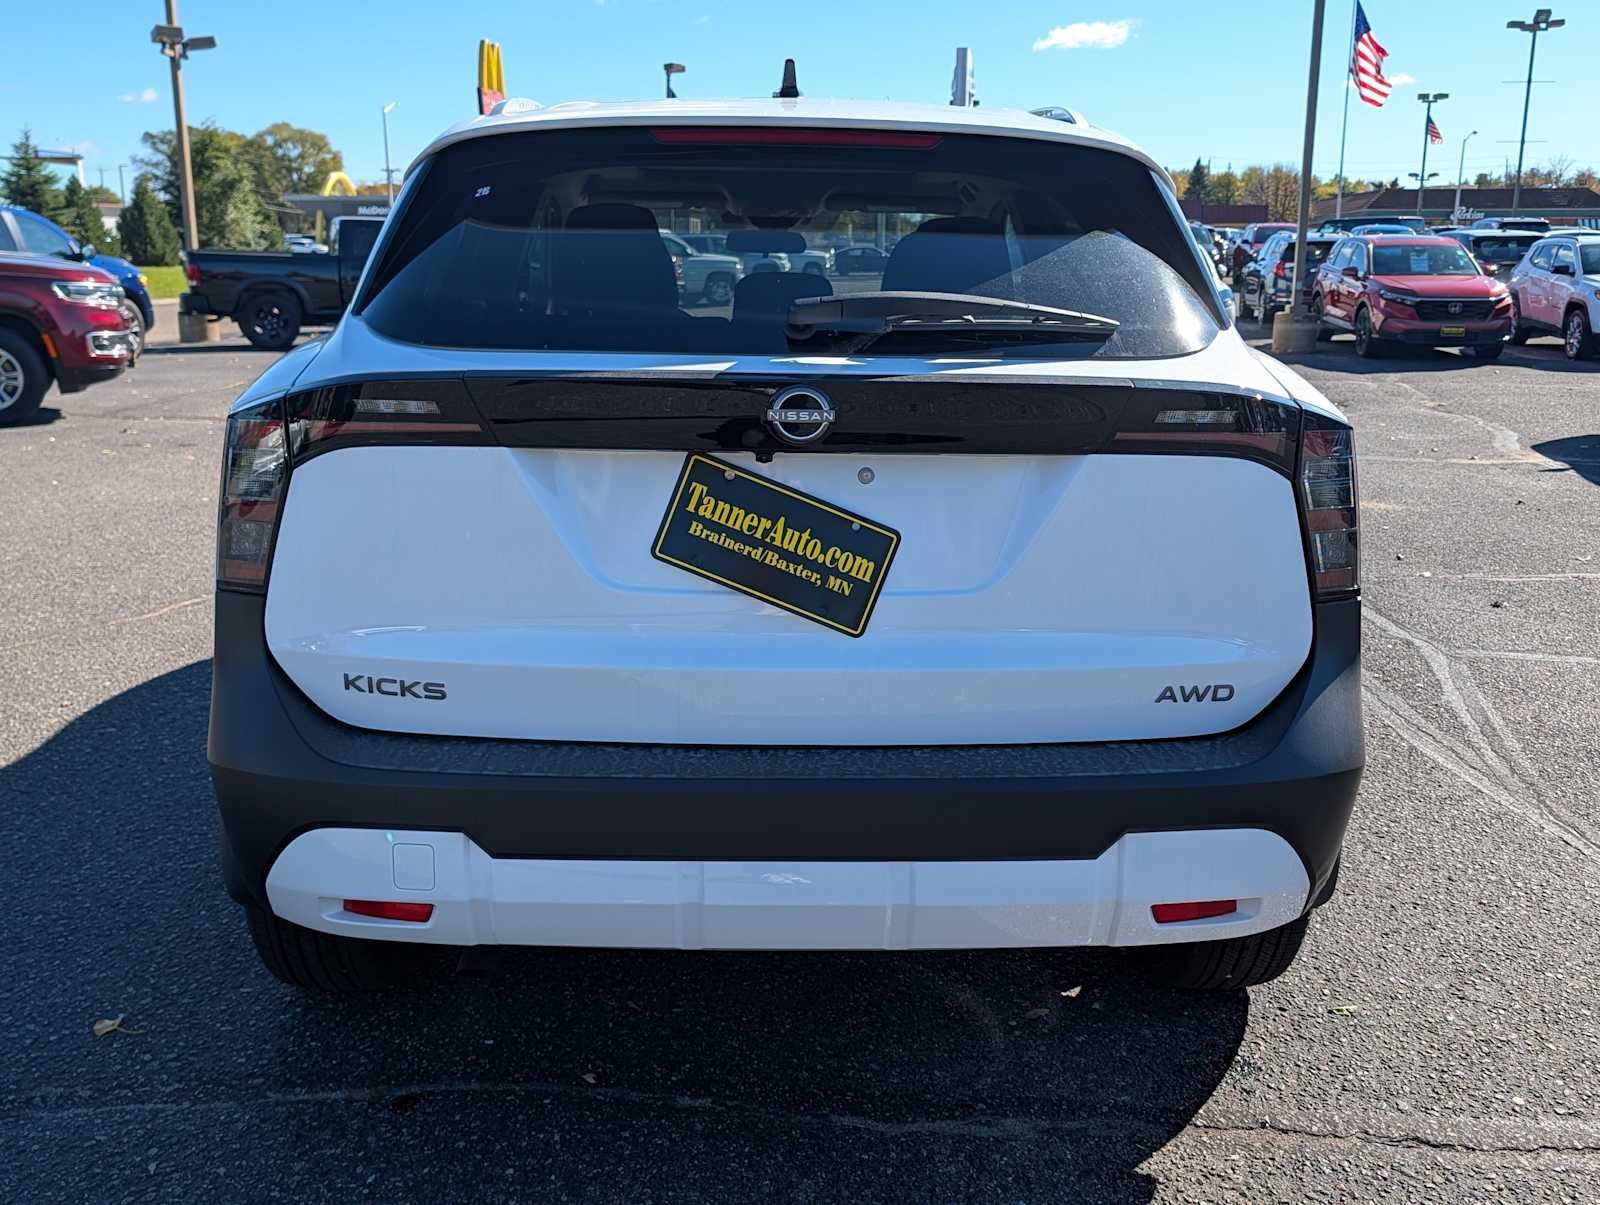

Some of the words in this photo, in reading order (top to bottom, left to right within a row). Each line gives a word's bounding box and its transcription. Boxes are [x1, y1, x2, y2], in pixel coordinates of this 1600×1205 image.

[357, 206, 389, 215] McDon
[769, 410, 834, 422] NISSAN
[684, 481, 876, 583] TannerAuto.com
[687, 520, 823, 586] Brainerd/Baxter,
[825, 575, 854, 597] MN
[343, 672, 448, 700] KICKS
[1154, 684, 1236, 703] AWD
